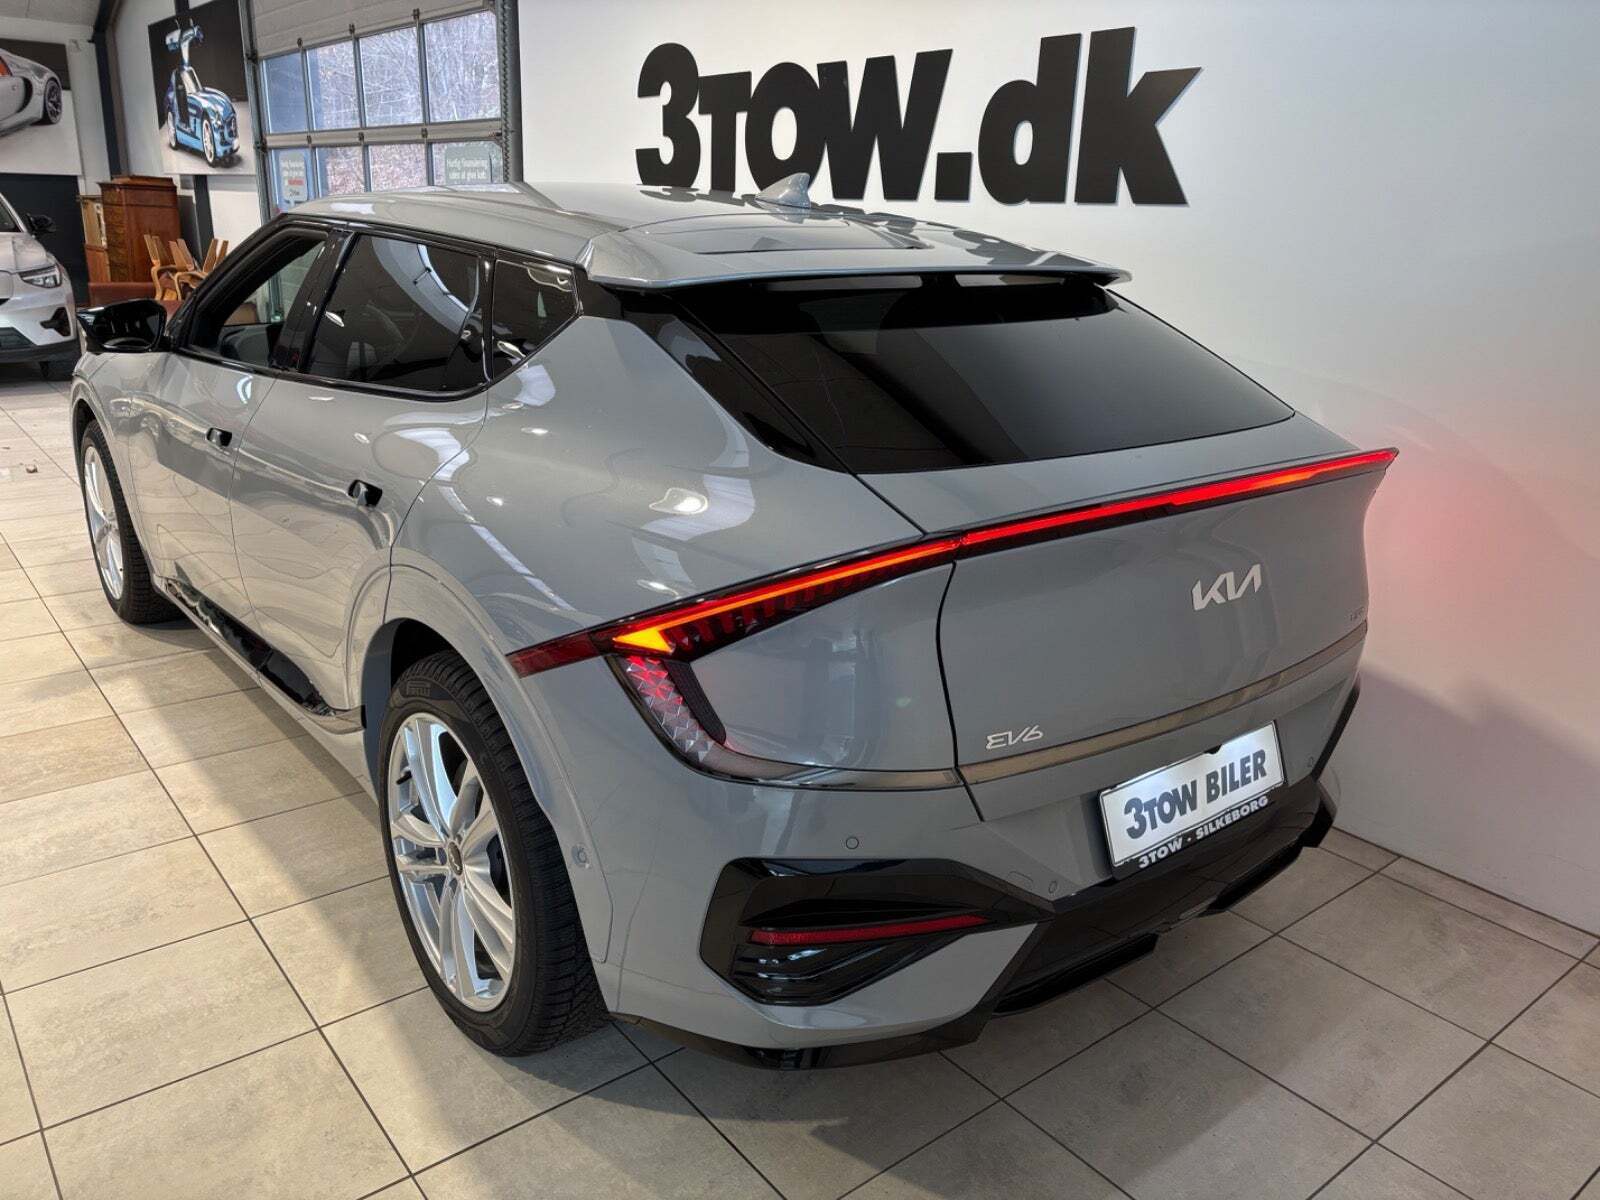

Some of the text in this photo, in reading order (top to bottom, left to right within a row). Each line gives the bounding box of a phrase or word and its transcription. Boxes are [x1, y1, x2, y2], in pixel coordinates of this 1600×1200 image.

[635, 26, 1203, 206] 3TOW.dk
[1191, 563, 1262, 611] KIA
[985, 724, 1043, 750] EV6
[1124, 749, 1266, 840] 3TOW BILER
[1138, 795, 1268, 869] 3TOW SILKEBORG
